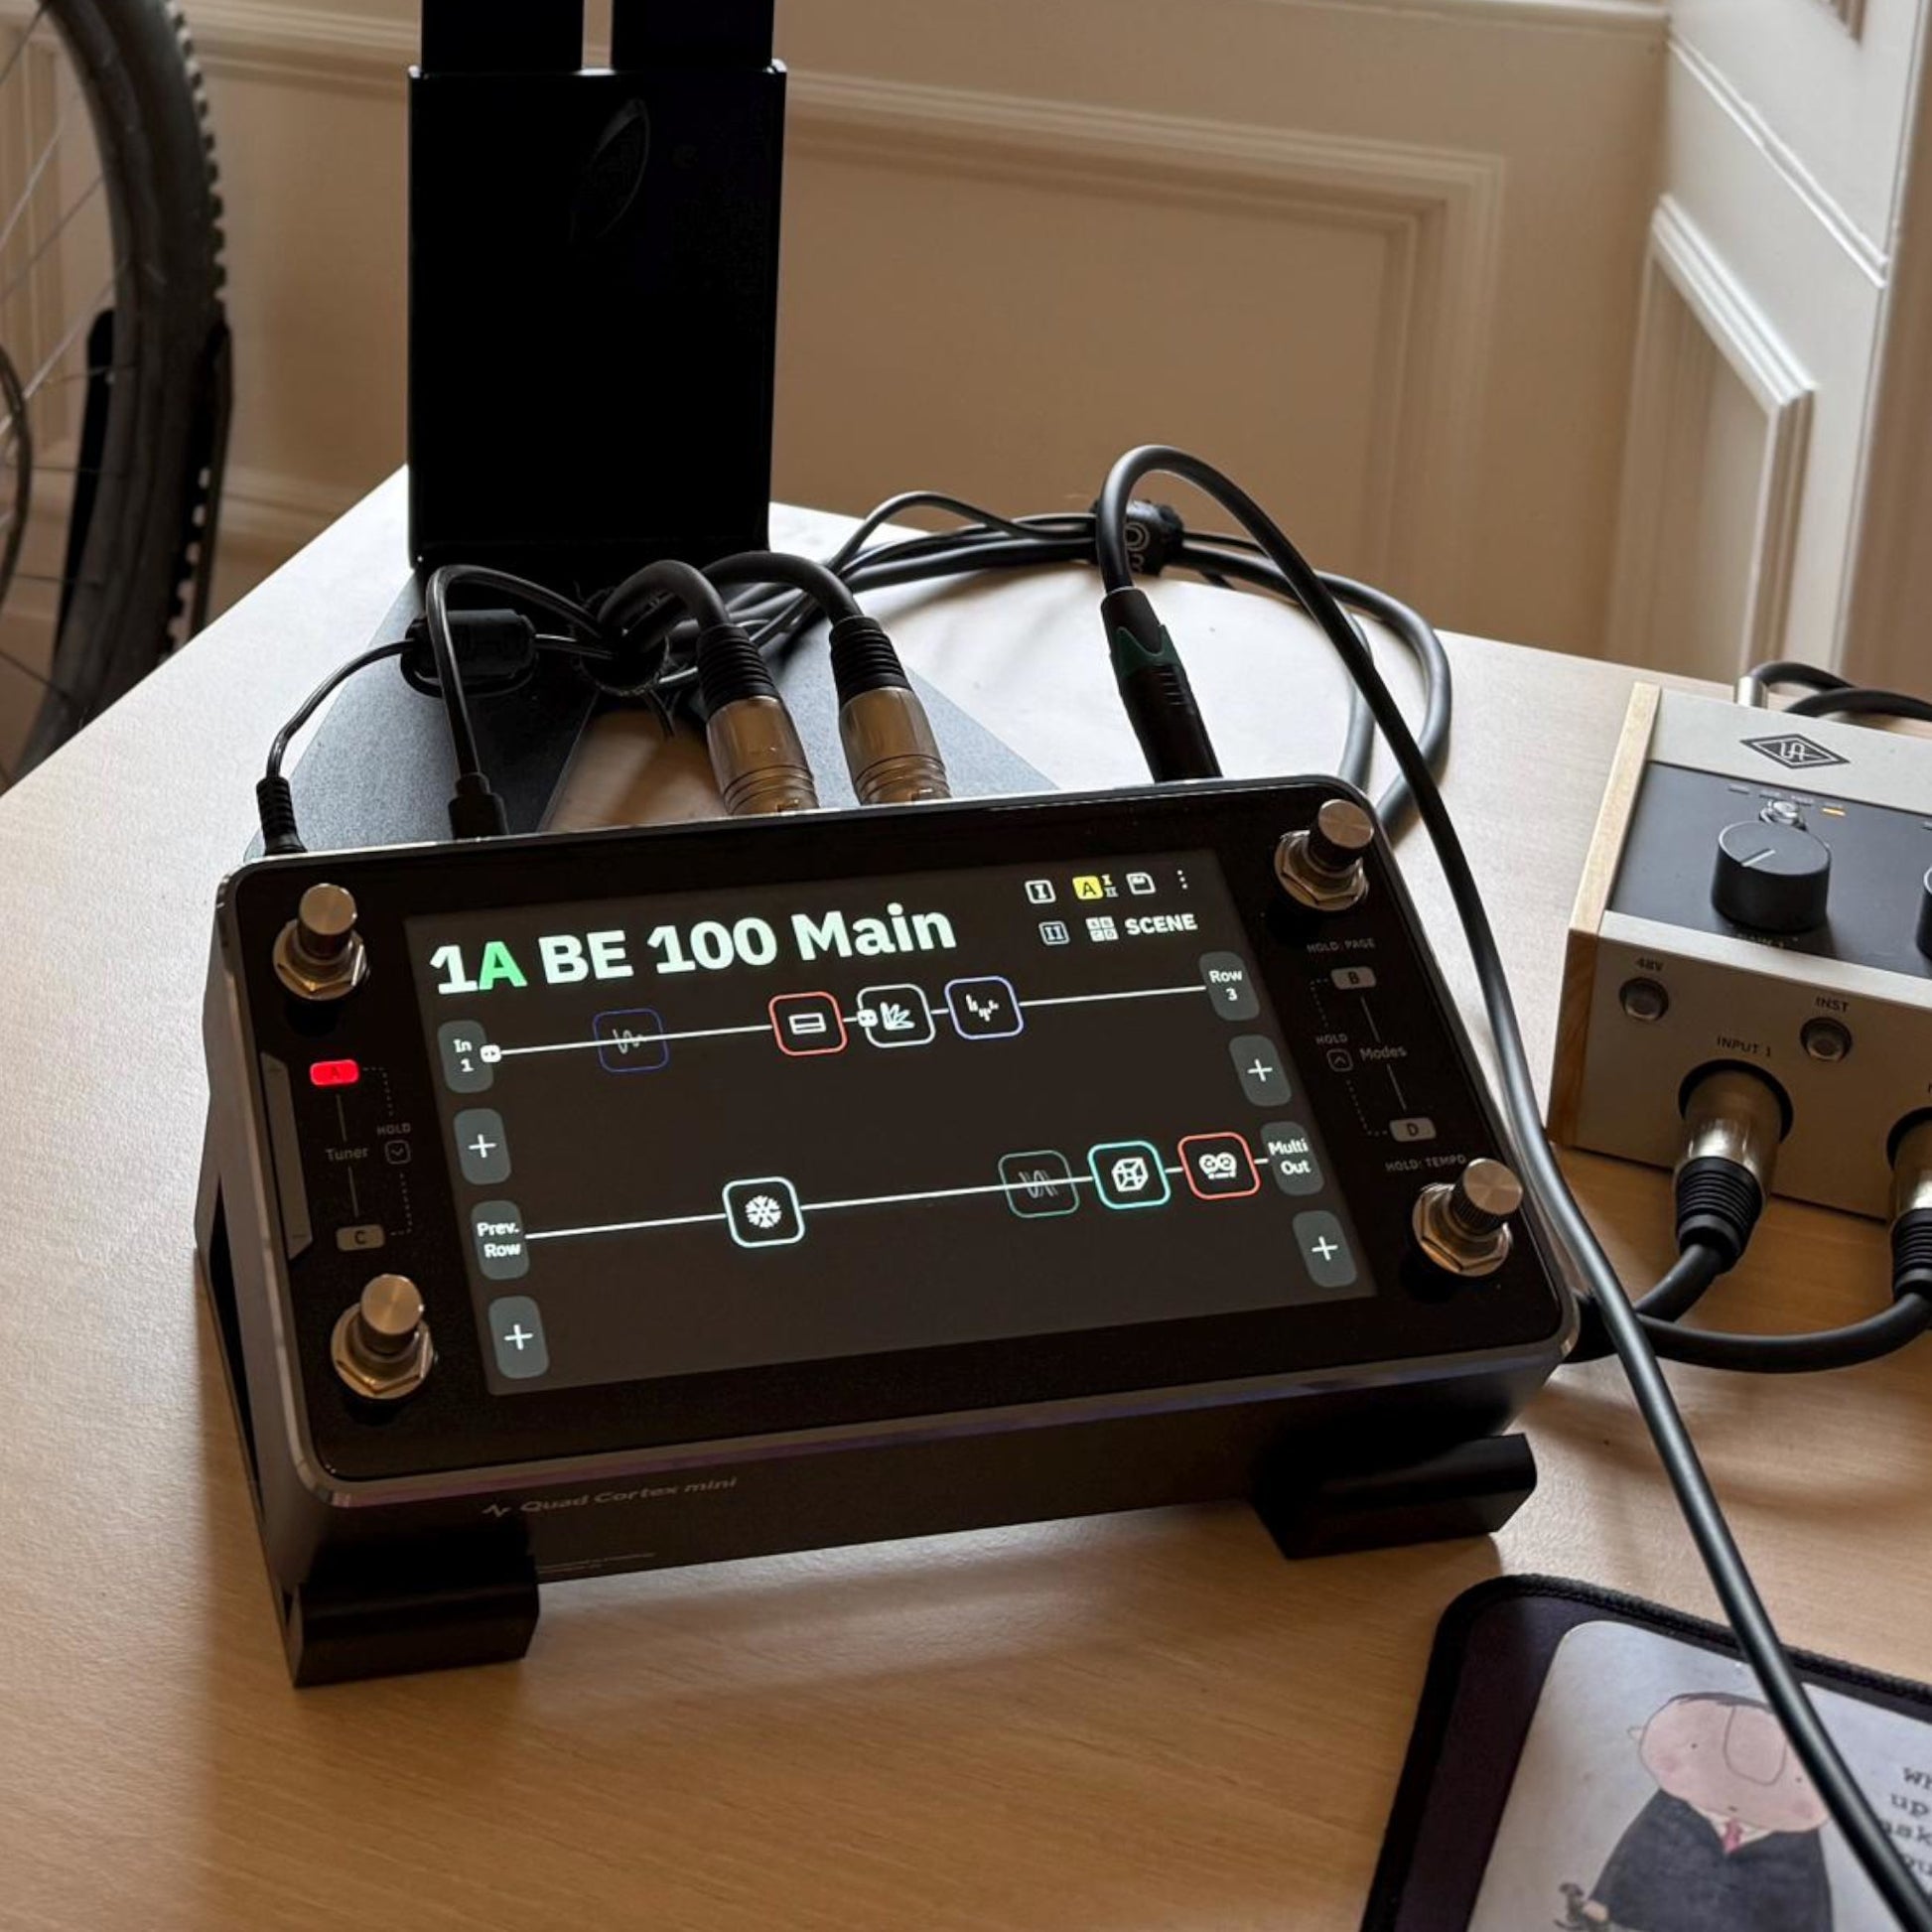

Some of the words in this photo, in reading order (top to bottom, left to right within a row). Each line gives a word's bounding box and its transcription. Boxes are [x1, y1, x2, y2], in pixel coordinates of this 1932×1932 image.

[1082, 882, 1097, 896] A
[1124, 913, 1198, 935] SCENE
[430, 941, 527, 994] 1A
[538, 929, 634, 985] BE
[647, 916, 777, 975] 100
[791, 902, 956, 961] Main
[1635, 957, 1664, 972] 48V
[1208, 969, 1243, 984] Row
[1348, 972, 1360, 985] B
[1226, 989, 1238, 1002] 3
[1815, 996, 1849, 1013] INST
[453, 1038, 473, 1053] In
[1315, 1034, 1348, 1044] HOLD
[1716, 1035, 1761, 1055] INPUT
[1764, 1043, 1772, 1057] 1
[1359, 1044, 1408, 1061] Modes
[460, 1057, 474, 1073] 1
[376, 1123, 411, 1136] HOLD
[1406, 1123, 1419, 1137] D
[1268, 1137, 1309, 1156] Multi
[325, 1147, 368, 1162] Tuner
[1425, 1154, 1466, 1168] TEMPO
[1280, 1160, 1311, 1175] Out
[477, 1221, 520, 1237] Prev.
[354, 1230, 366, 1245] C
[483, 1242, 521, 1258] Row
[520, 1495, 590, 1513] Quad
[594, 1485, 677, 1503] Cortex
[684, 1476, 738, 1492] mini
[1890, 1792, 1930, 1818] up
